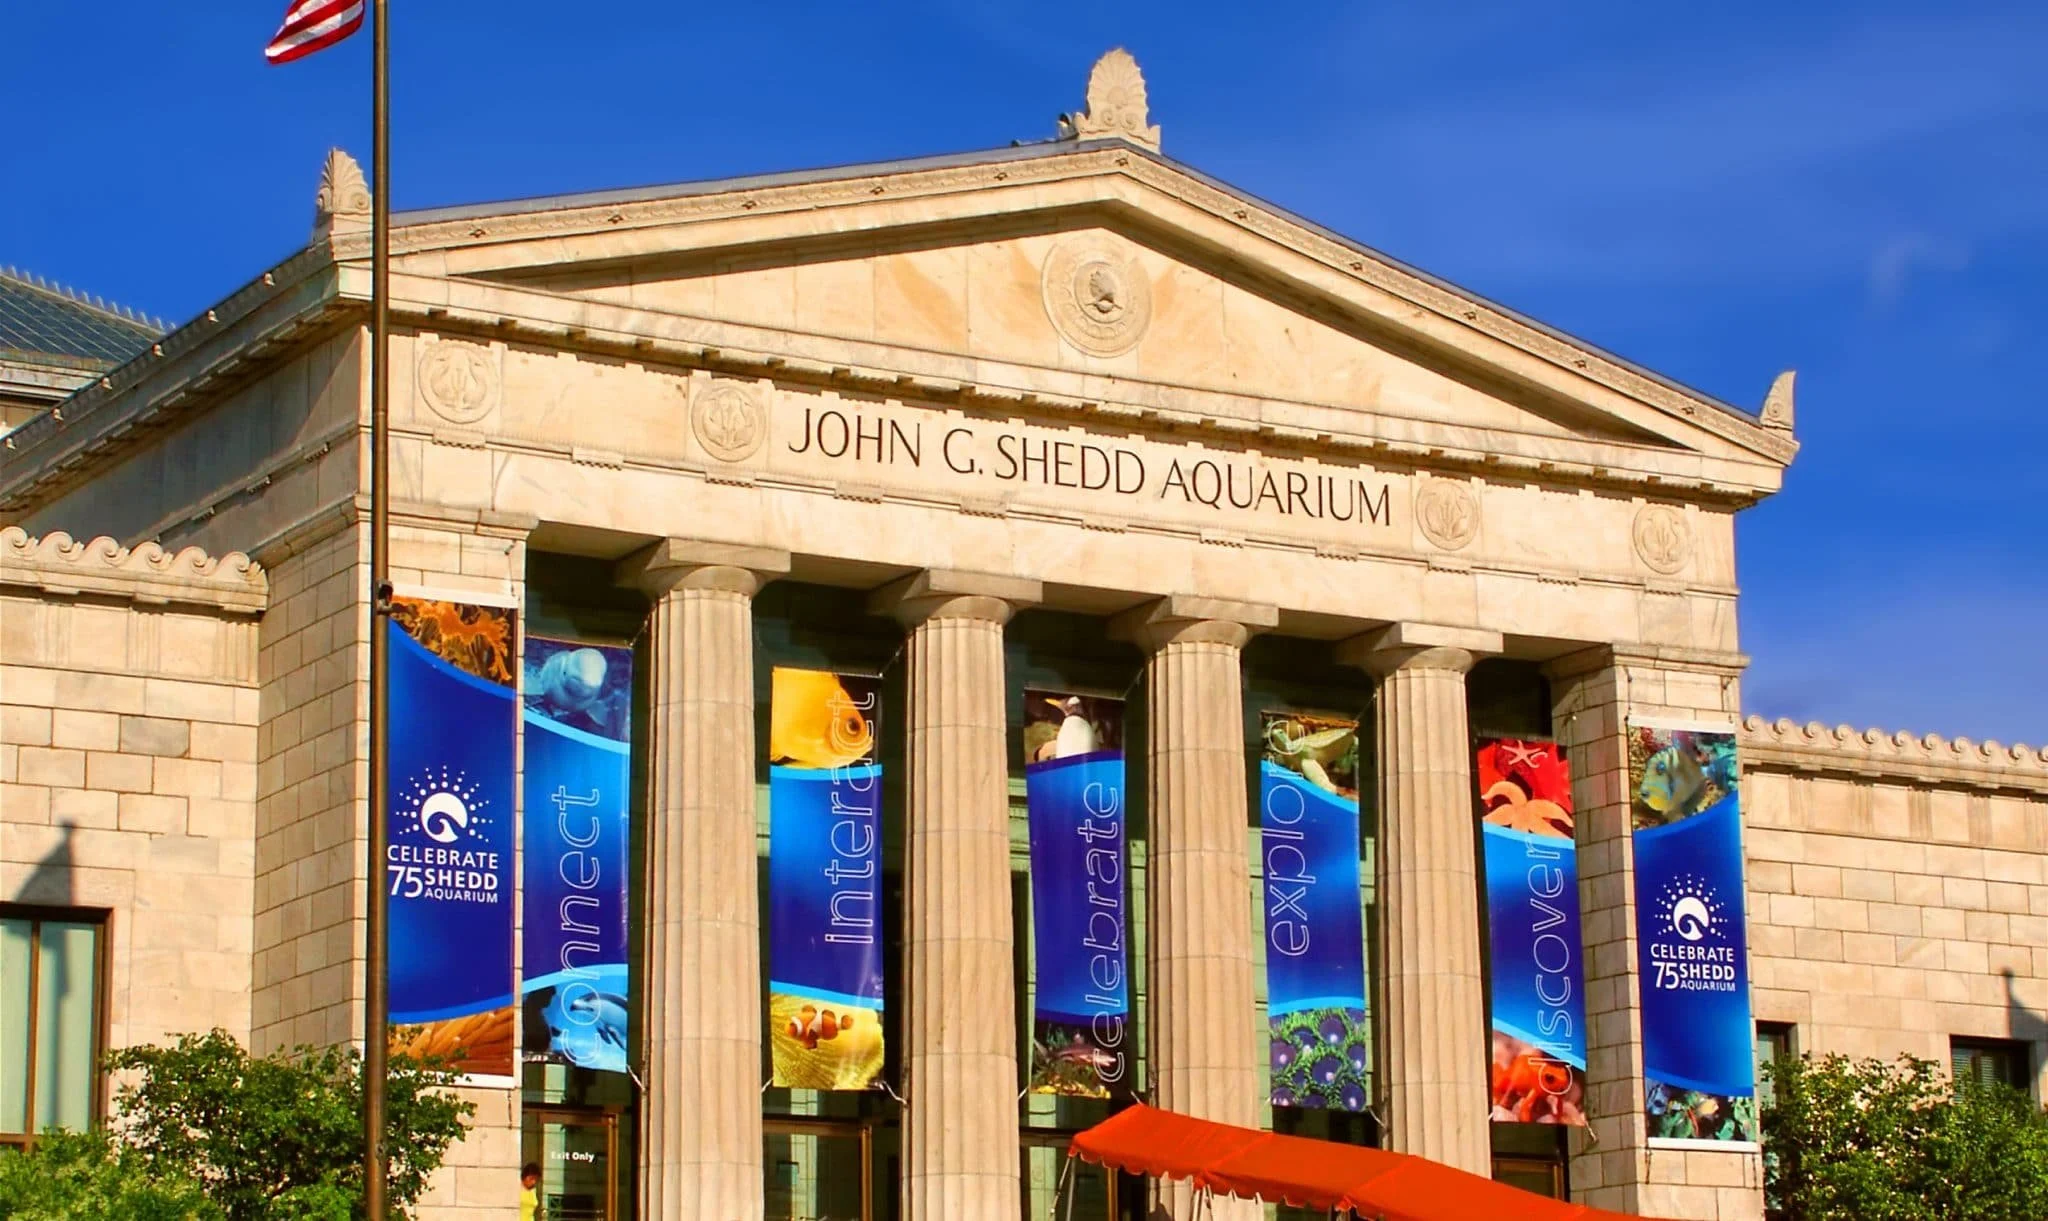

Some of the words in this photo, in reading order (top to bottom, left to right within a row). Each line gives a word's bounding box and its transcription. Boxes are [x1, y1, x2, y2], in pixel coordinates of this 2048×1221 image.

[788, 408, 921, 467] JOHN
[943, 428, 984, 477] G.
[995, 433, 1146, 495] SHEDD
[1160, 458, 1392, 527] AQUARIUM
[825, 691, 875, 944] interact
[1261, 719, 1316, 957] explore
[387, 844, 499, 870] CELEBRATE
[387, 864, 423, 898] 75
[424, 868, 498, 890] SHEDD
[424, 887, 498, 903] AQUARIUM
[551, 785, 600, 1064] connect
[1077, 782, 1125, 1082] celebrate
[1526, 834, 1573, 1096] discover
[1650, 943, 1734, 962] CELEBRATE
[1652, 961, 1679, 989] 75
[1679, 963, 1735, 980] SHEDD
[1679, 979, 1736, 992] AQUARIUM
[551, 1151, 570, 1160] Exit
[572, 1151, 595, 1162] Only
